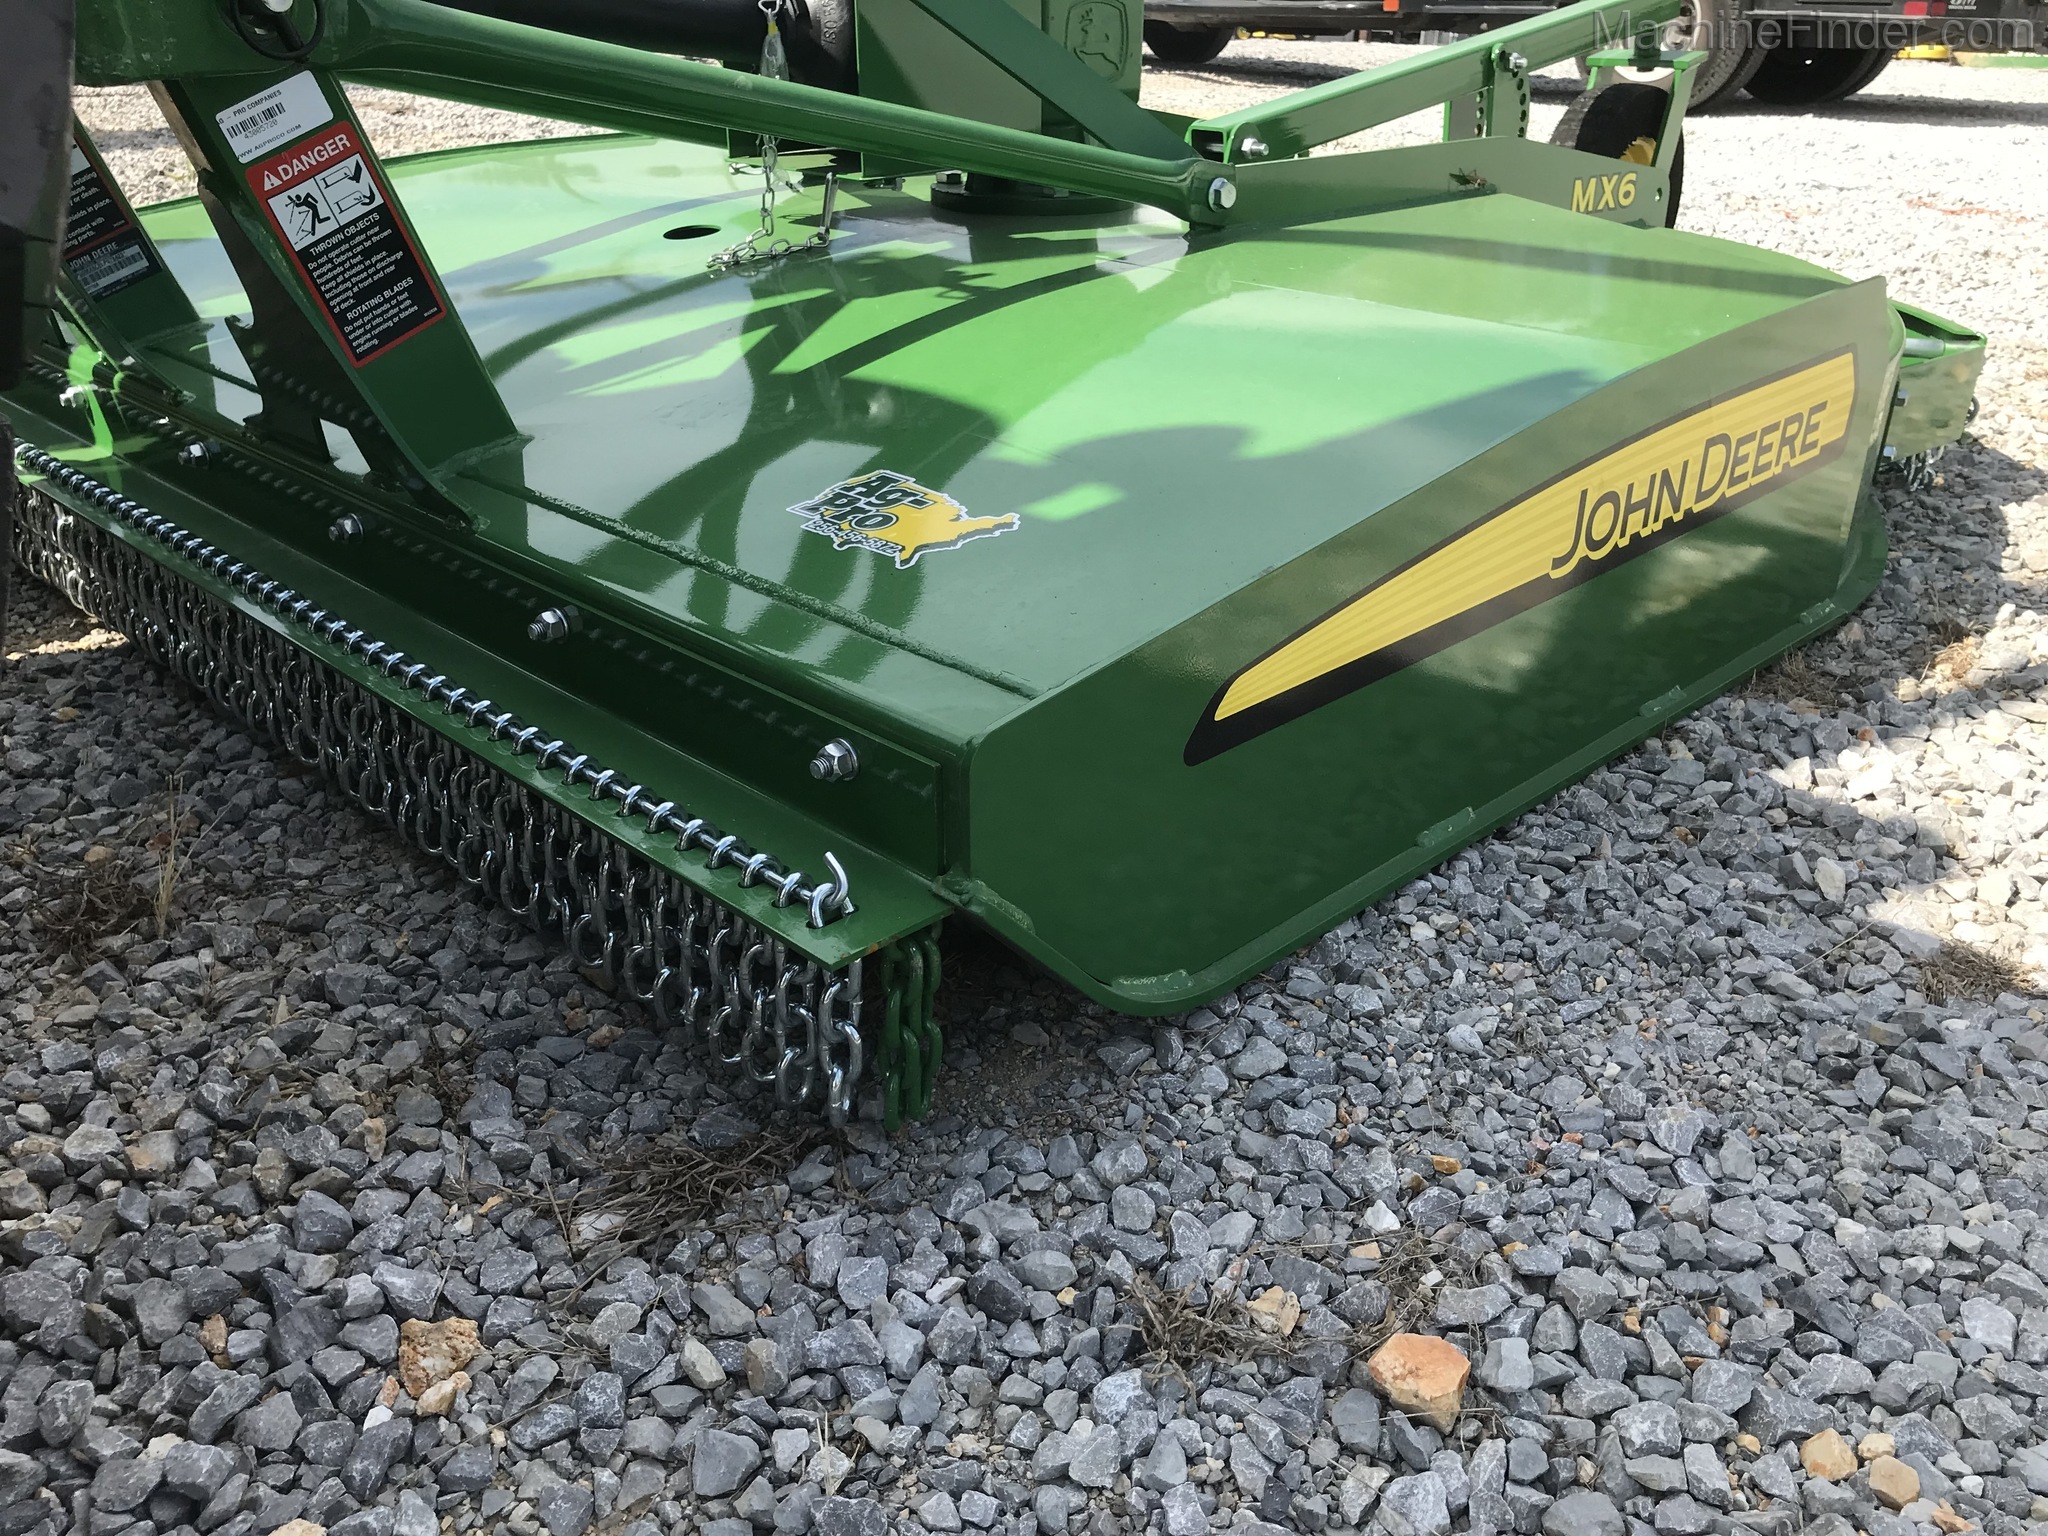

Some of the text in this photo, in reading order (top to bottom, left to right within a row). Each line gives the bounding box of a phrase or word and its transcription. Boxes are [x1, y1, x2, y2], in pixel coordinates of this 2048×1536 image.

[233, 107, 246, 117] PRO
[247, 90, 282, 110] COMPANIES
[277, 134, 351, 181] DANGER
[73, 172, 97, 186] rotating
[1571, 172, 1637, 213] MX6
[68, 224, 91, 239] contact
[91, 216, 105, 226] with
[87, 205, 94, 213] in
[308, 226, 380, 270] Do not operate cutter near
[309, 212, 380, 256] THROWN OBJECTS
[312, 229, 392, 278] people. Debris can be thrown
[69, 254, 91, 269] JOHN
[91, 241, 119, 259] DEERE
[317, 266, 344, 284] hundreds
[344, 260, 350, 268] of
[351, 271, 368, 283] those
[376, 251, 403, 269] discharge
[321, 280, 336, 292] Keep
[336, 274, 344, 283] all
[344, 263, 364, 278] shields
[365, 259, 371, 267] in
[330, 290, 353, 306] opening
[359, 278, 373, 289] front
[373, 271, 384, 280] and
[384, 264, 396, 274] rear
[334, 298, 356, 314] of deck.
[344, 325, 353, 333] Do
[354, 318, 364, 328] not
[363, 313, 373, 323] put
[373, 303, 391, 316] hands
[397, 291, 409, 301] feet
[346, 277, 414, 320] ROTATING BLADES
[348, 328, 365, 340] under
[372, 316, 383, 326] into
[383, 307, 400, 319] cutter
[400, 299, 412, 309] with
[352, 333, 371, 347] engine
[371, 320, 394, 336] running
[399, 305, 418, 319] blades
[356, 338, 379, 354] rotating.
[1550, 400, 1829, 575] JOHN DEERE
[793, 491, 899, 530] Pro
[811, 520, 904, 554] 256-456-5872
